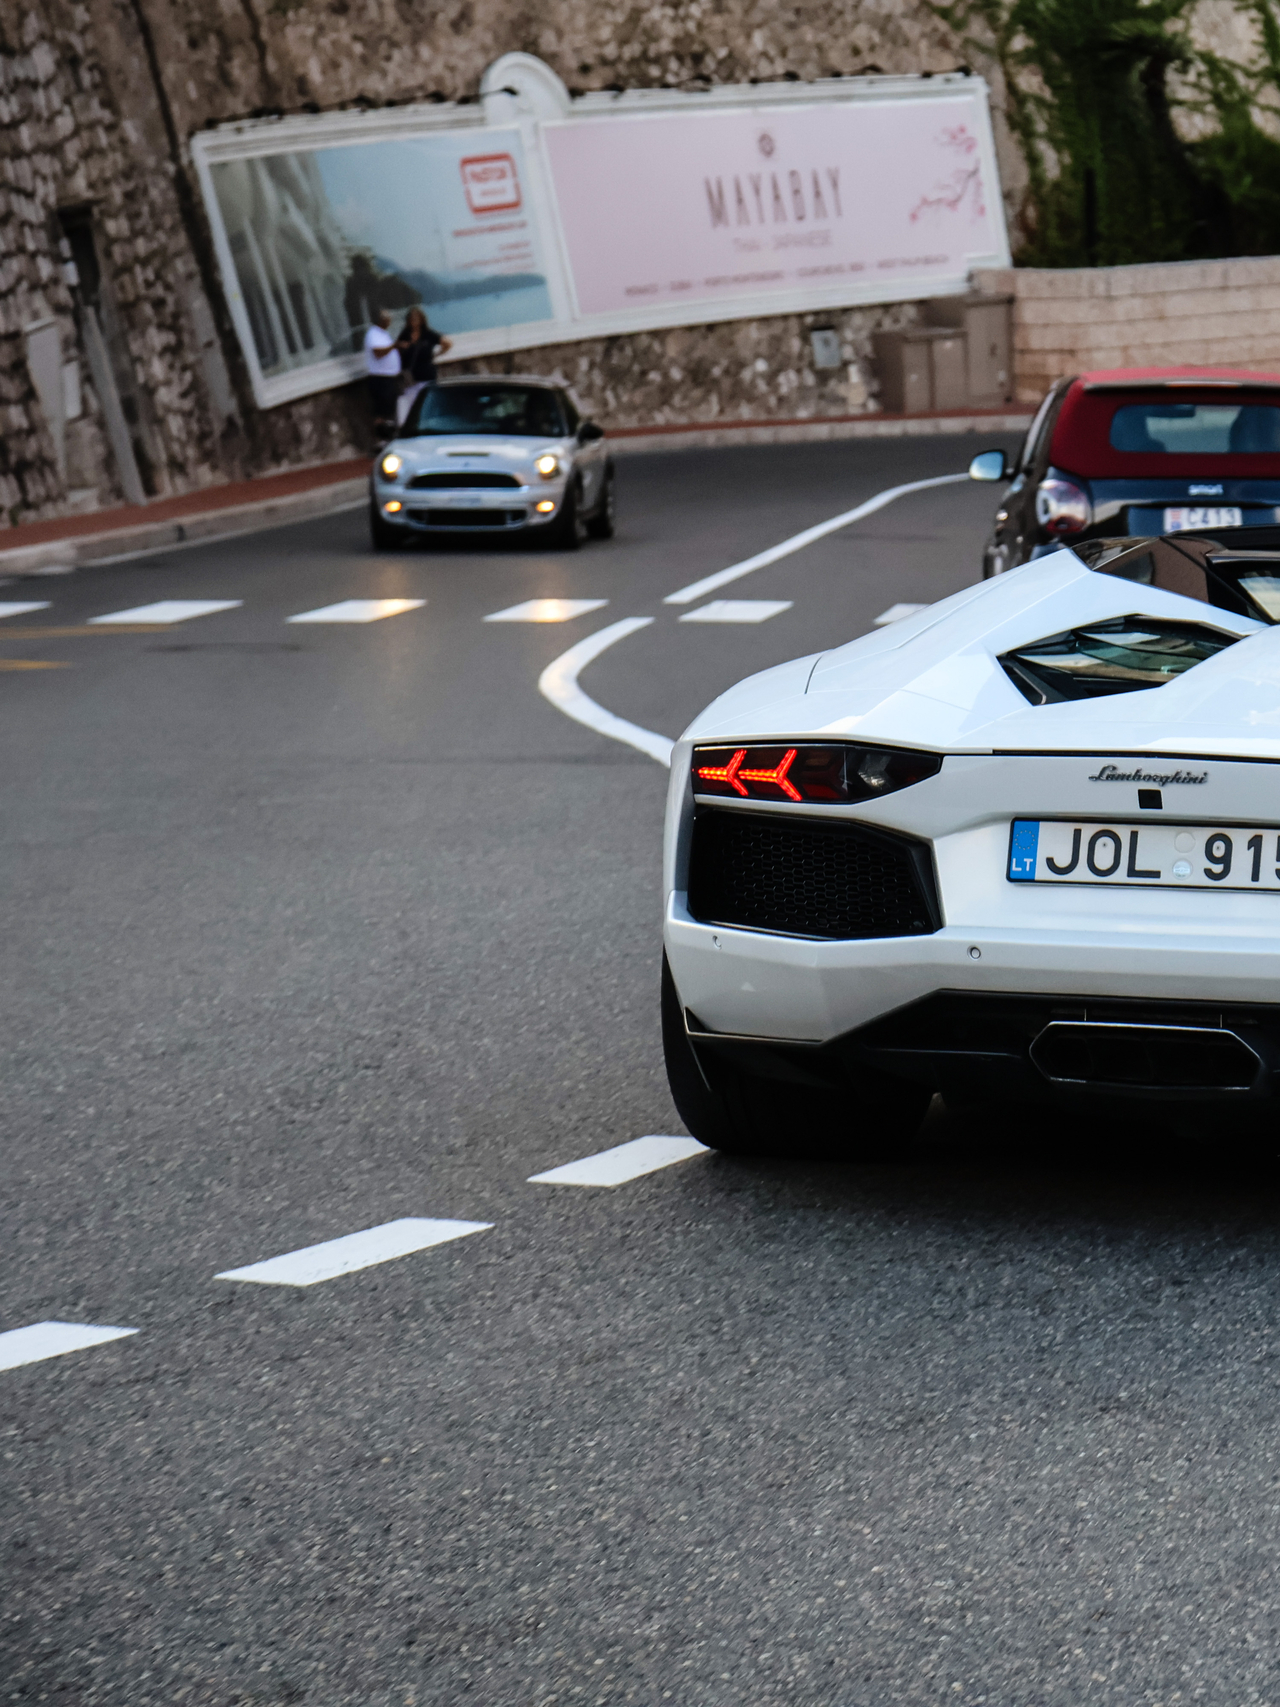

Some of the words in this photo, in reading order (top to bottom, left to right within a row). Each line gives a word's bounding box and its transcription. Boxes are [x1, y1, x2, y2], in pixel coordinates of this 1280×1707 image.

[1089, 764, 1208, 787] Lamborghini
[1013, 859, 1034, 872] LT
[1046, 828, 1162, 879] JOL
